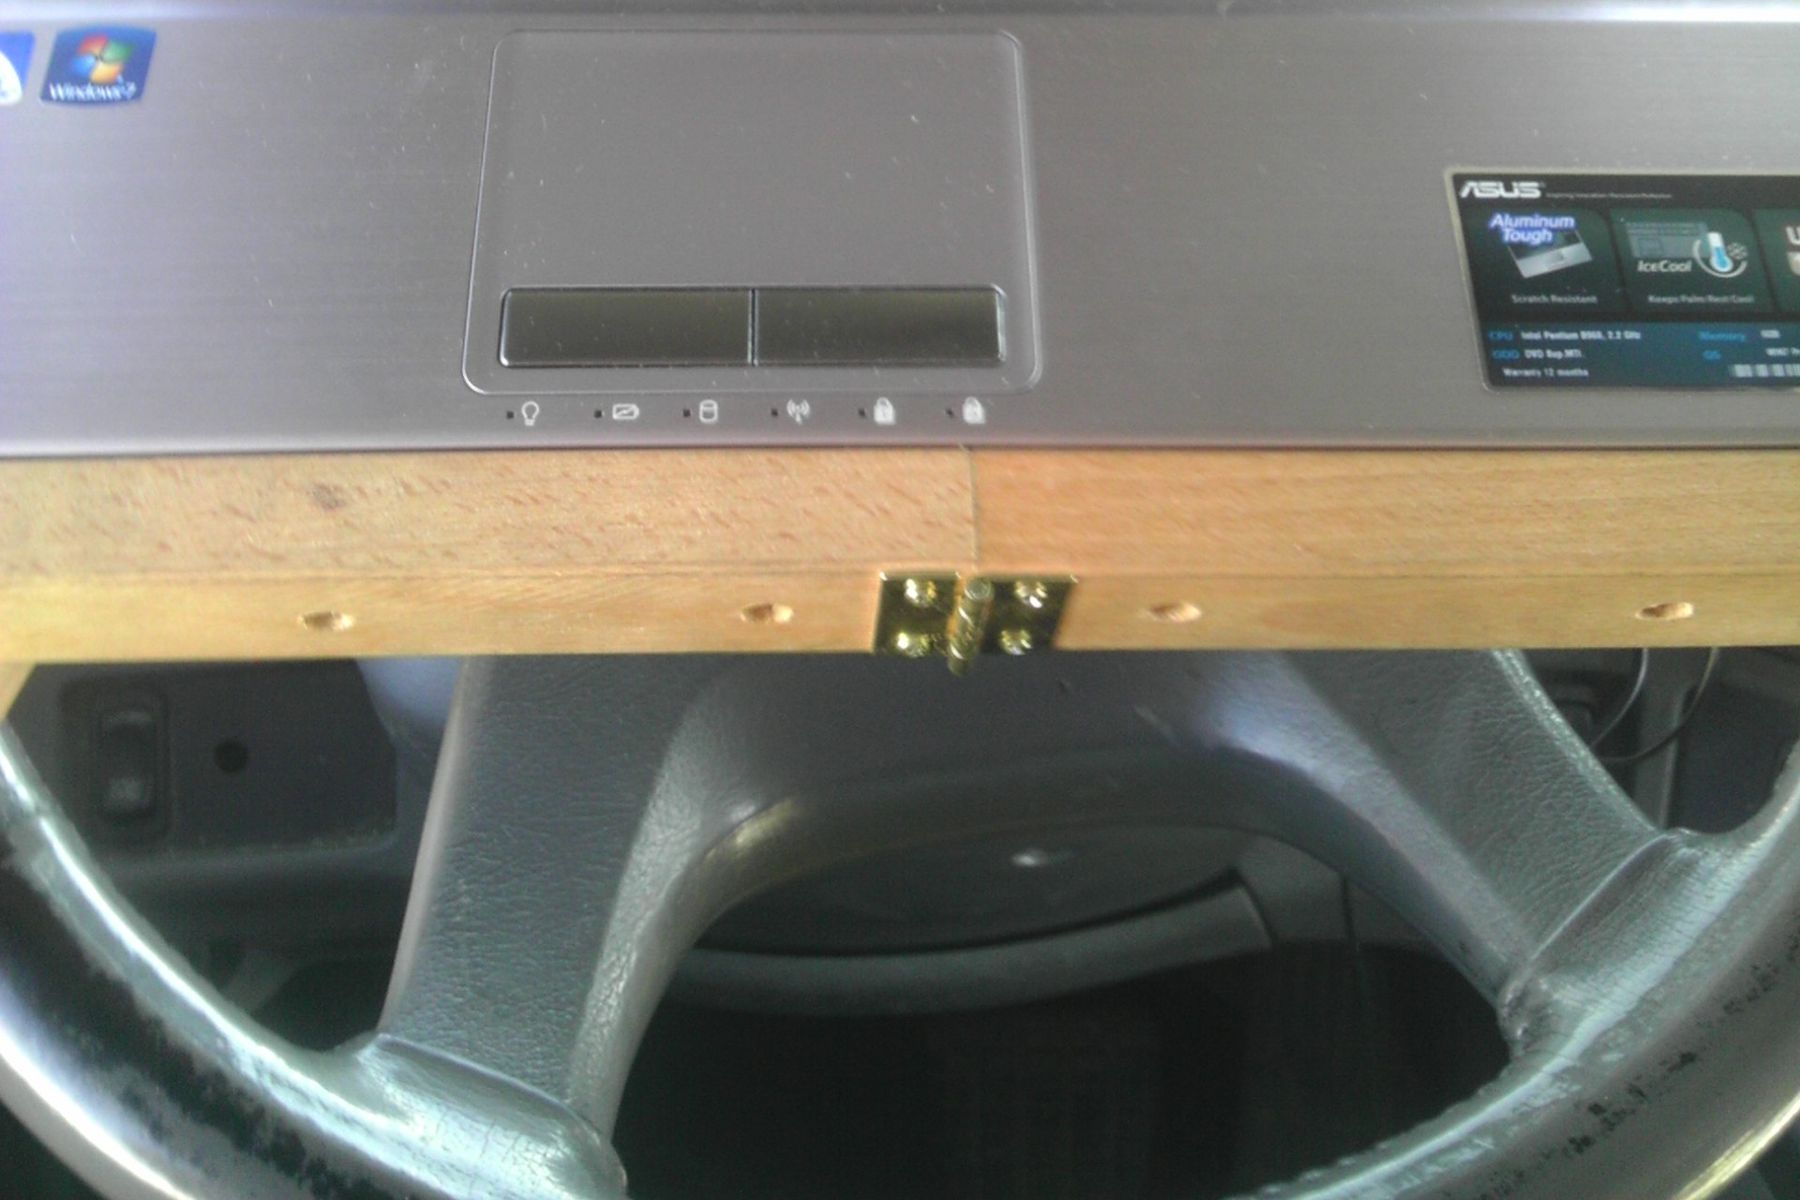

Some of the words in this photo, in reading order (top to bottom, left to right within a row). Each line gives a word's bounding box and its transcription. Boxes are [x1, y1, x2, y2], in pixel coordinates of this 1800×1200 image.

[1460, 181, 1542, 199] ASUS
[1489, 213, 1576, 230] Aluminum
[1502, 228, 1553, 245] Tough
[1637, 261, 1693, 273] IceCool
[1543, 330, 1579, 340] Pentium
